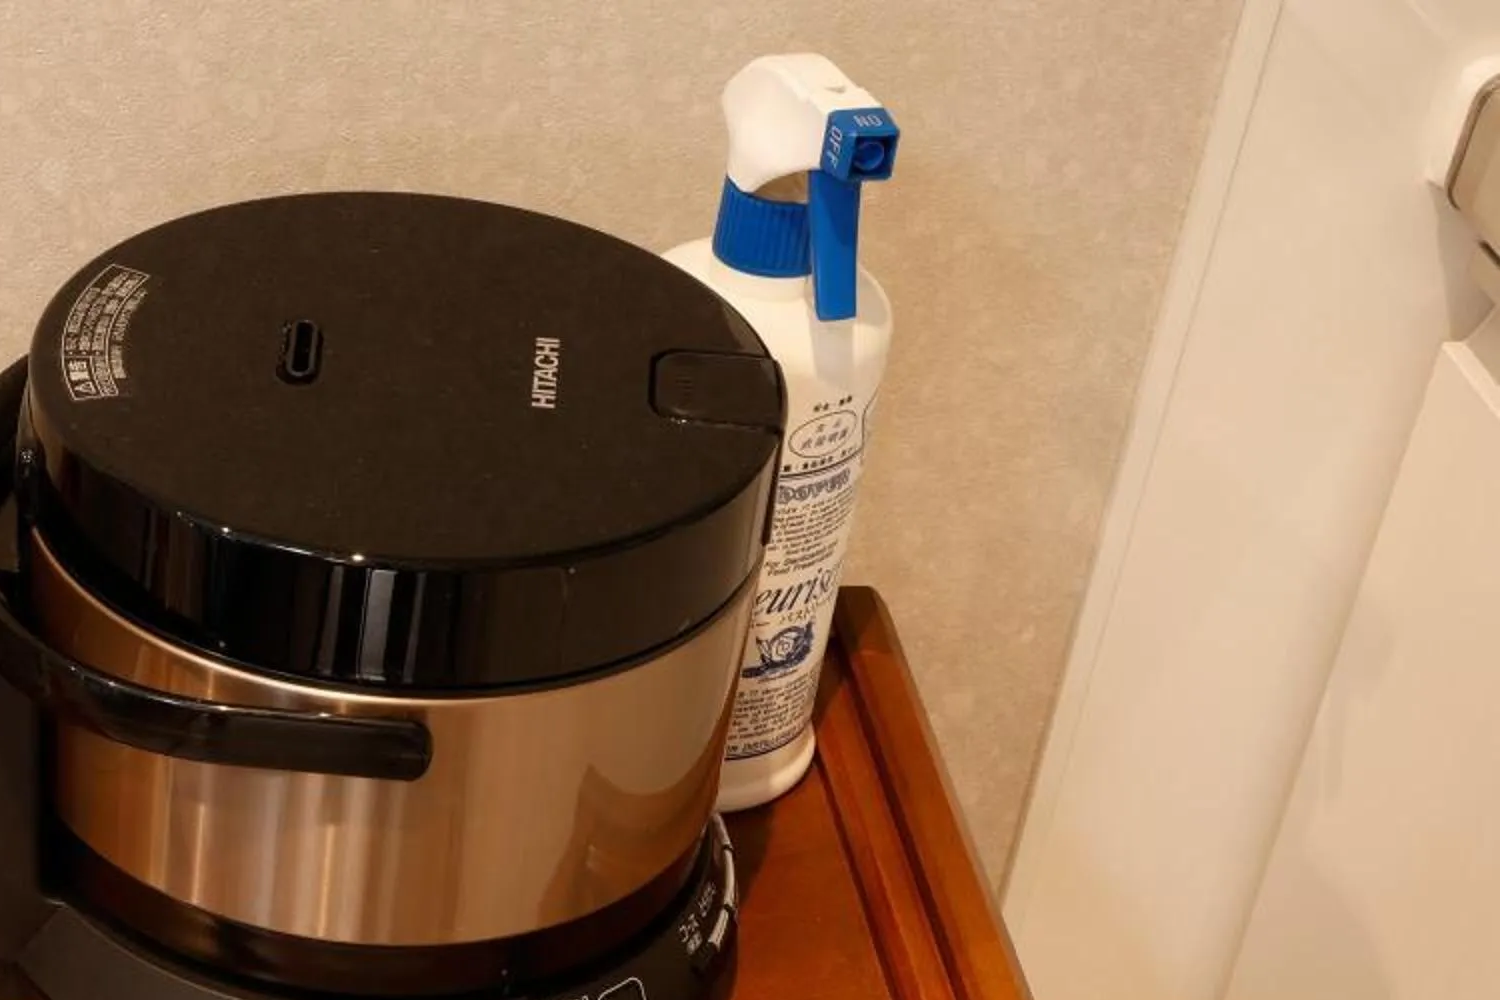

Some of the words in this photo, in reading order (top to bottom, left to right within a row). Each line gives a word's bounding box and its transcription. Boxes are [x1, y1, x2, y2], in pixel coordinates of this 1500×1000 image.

[853, 114, 883, 127] ON
[826, 125, 843, 169] OFF
[532, 337, 560, 408] HITACHI
